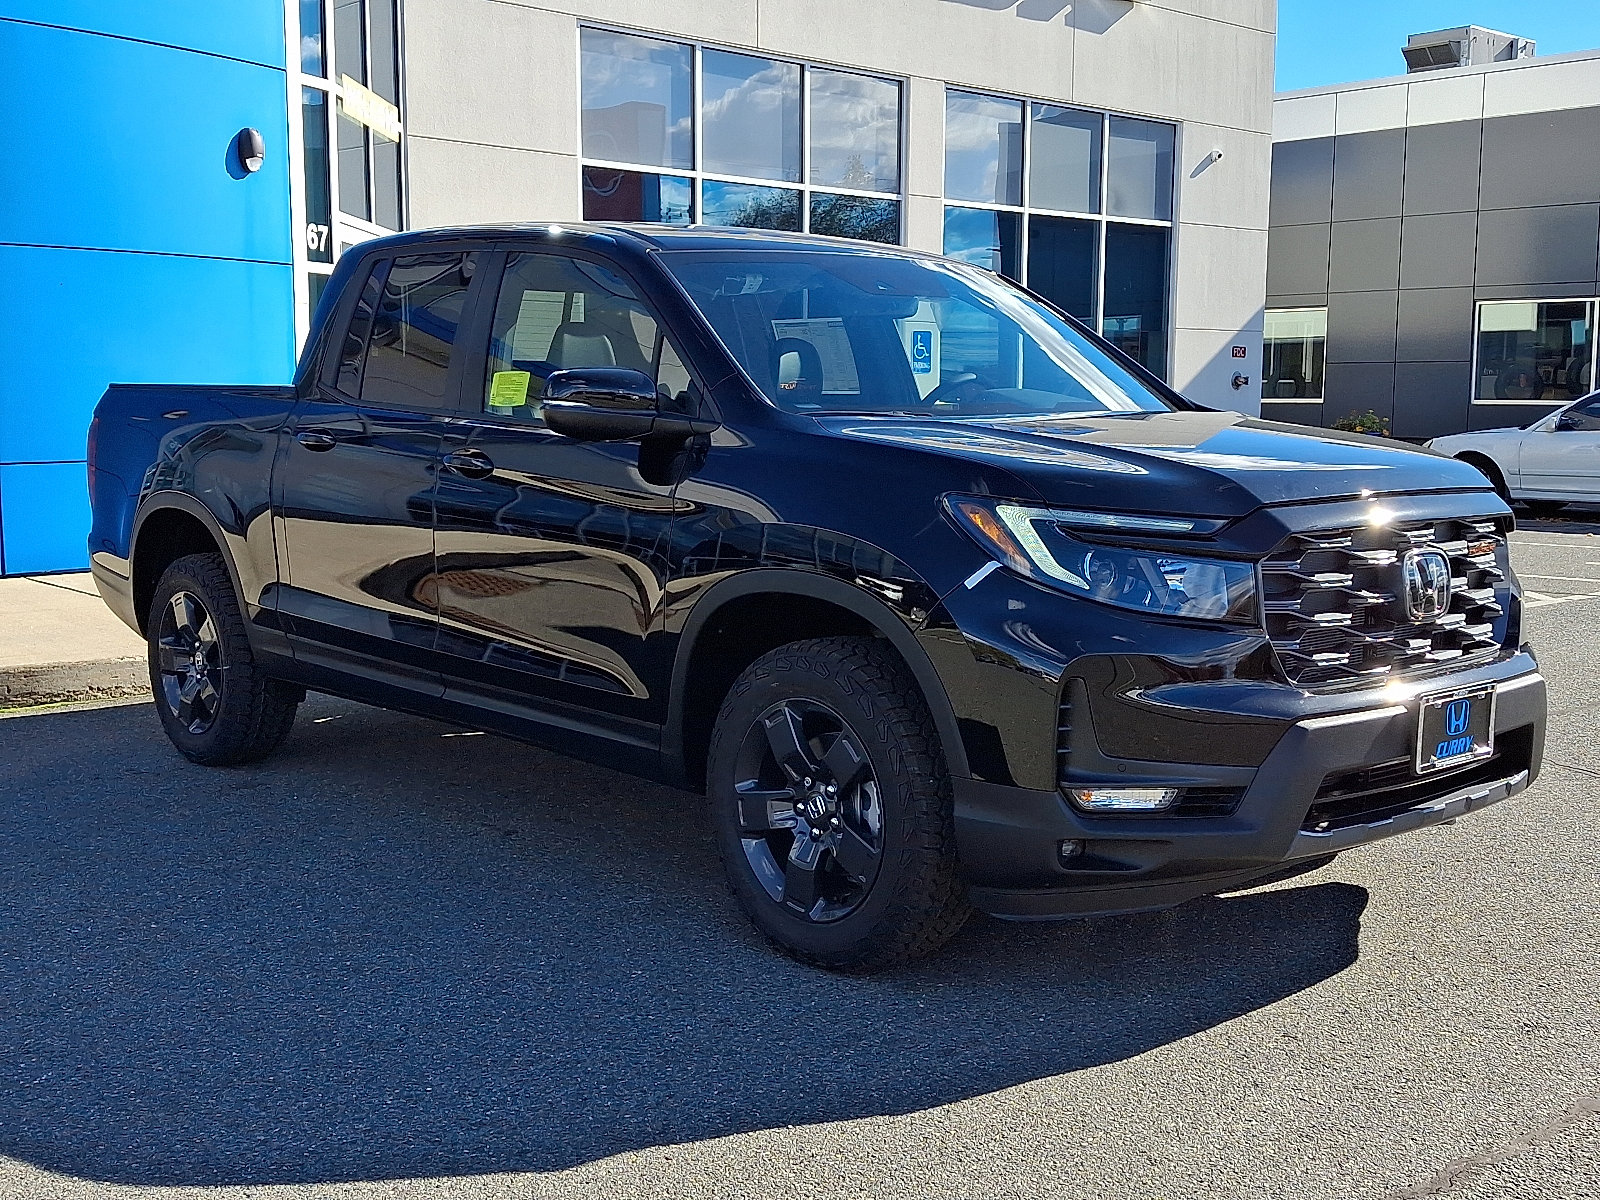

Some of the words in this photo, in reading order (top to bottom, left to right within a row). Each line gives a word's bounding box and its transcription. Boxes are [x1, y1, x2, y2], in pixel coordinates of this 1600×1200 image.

[307, 223, 328, 252] 67
[1233, 348, 1245, 357] FDC
[1435, 735, 1474, 759] CURRY
